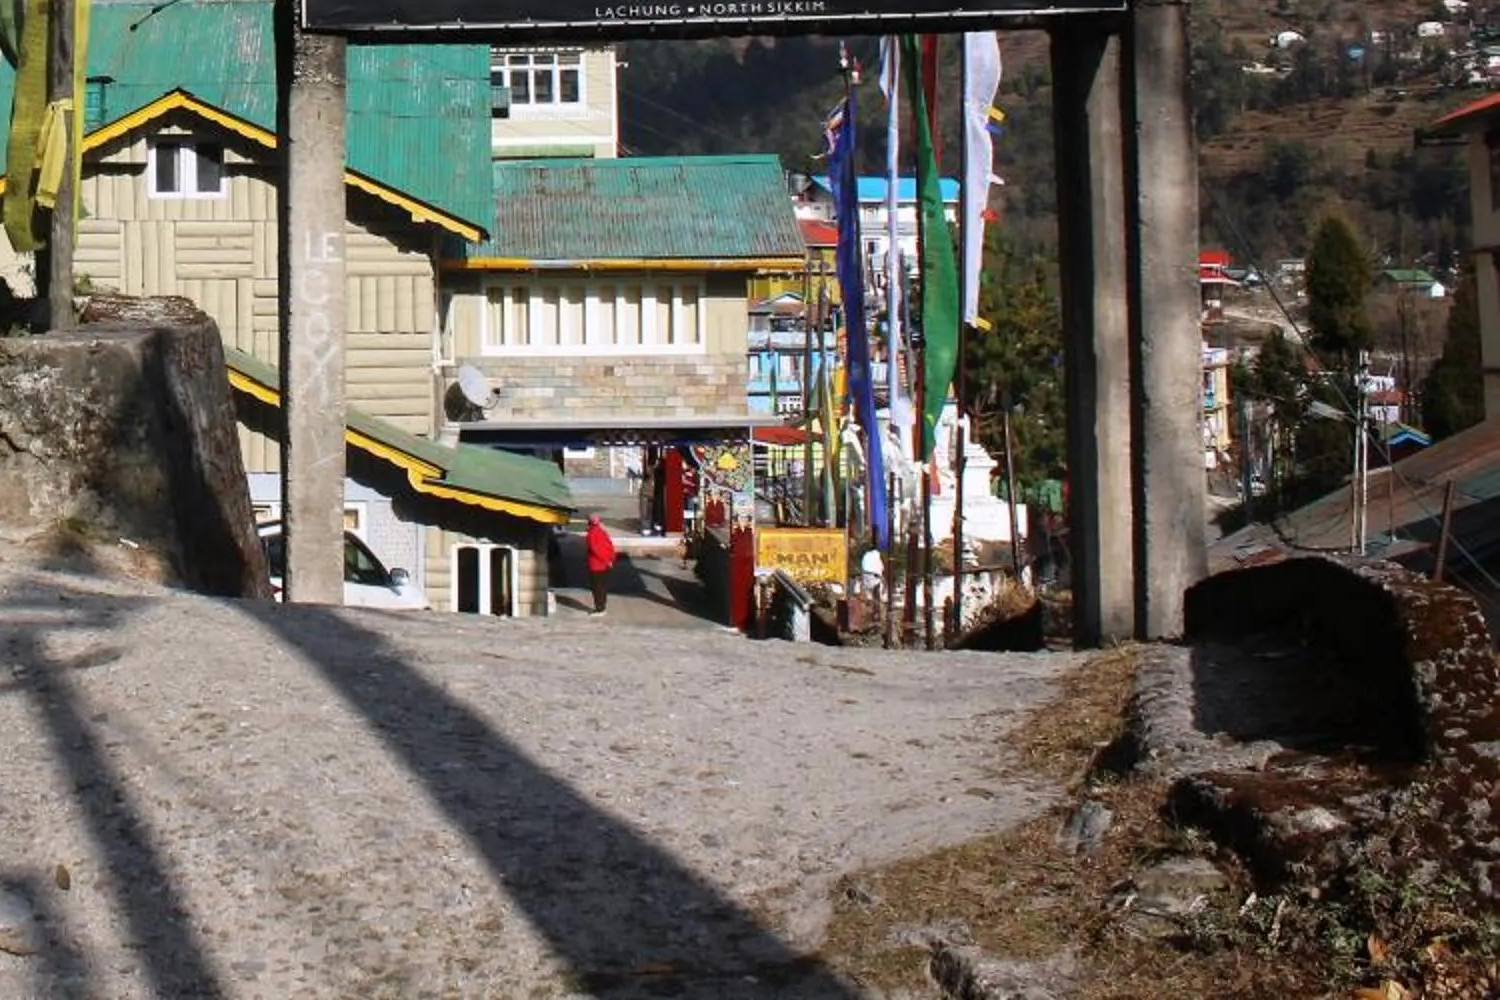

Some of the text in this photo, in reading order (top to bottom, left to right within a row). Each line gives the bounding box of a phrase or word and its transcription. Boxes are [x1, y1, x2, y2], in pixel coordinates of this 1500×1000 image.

[595, 1, 826, 18] LACHUNG NORTH SIKKIM
[305, 229, 343, 263] LE
